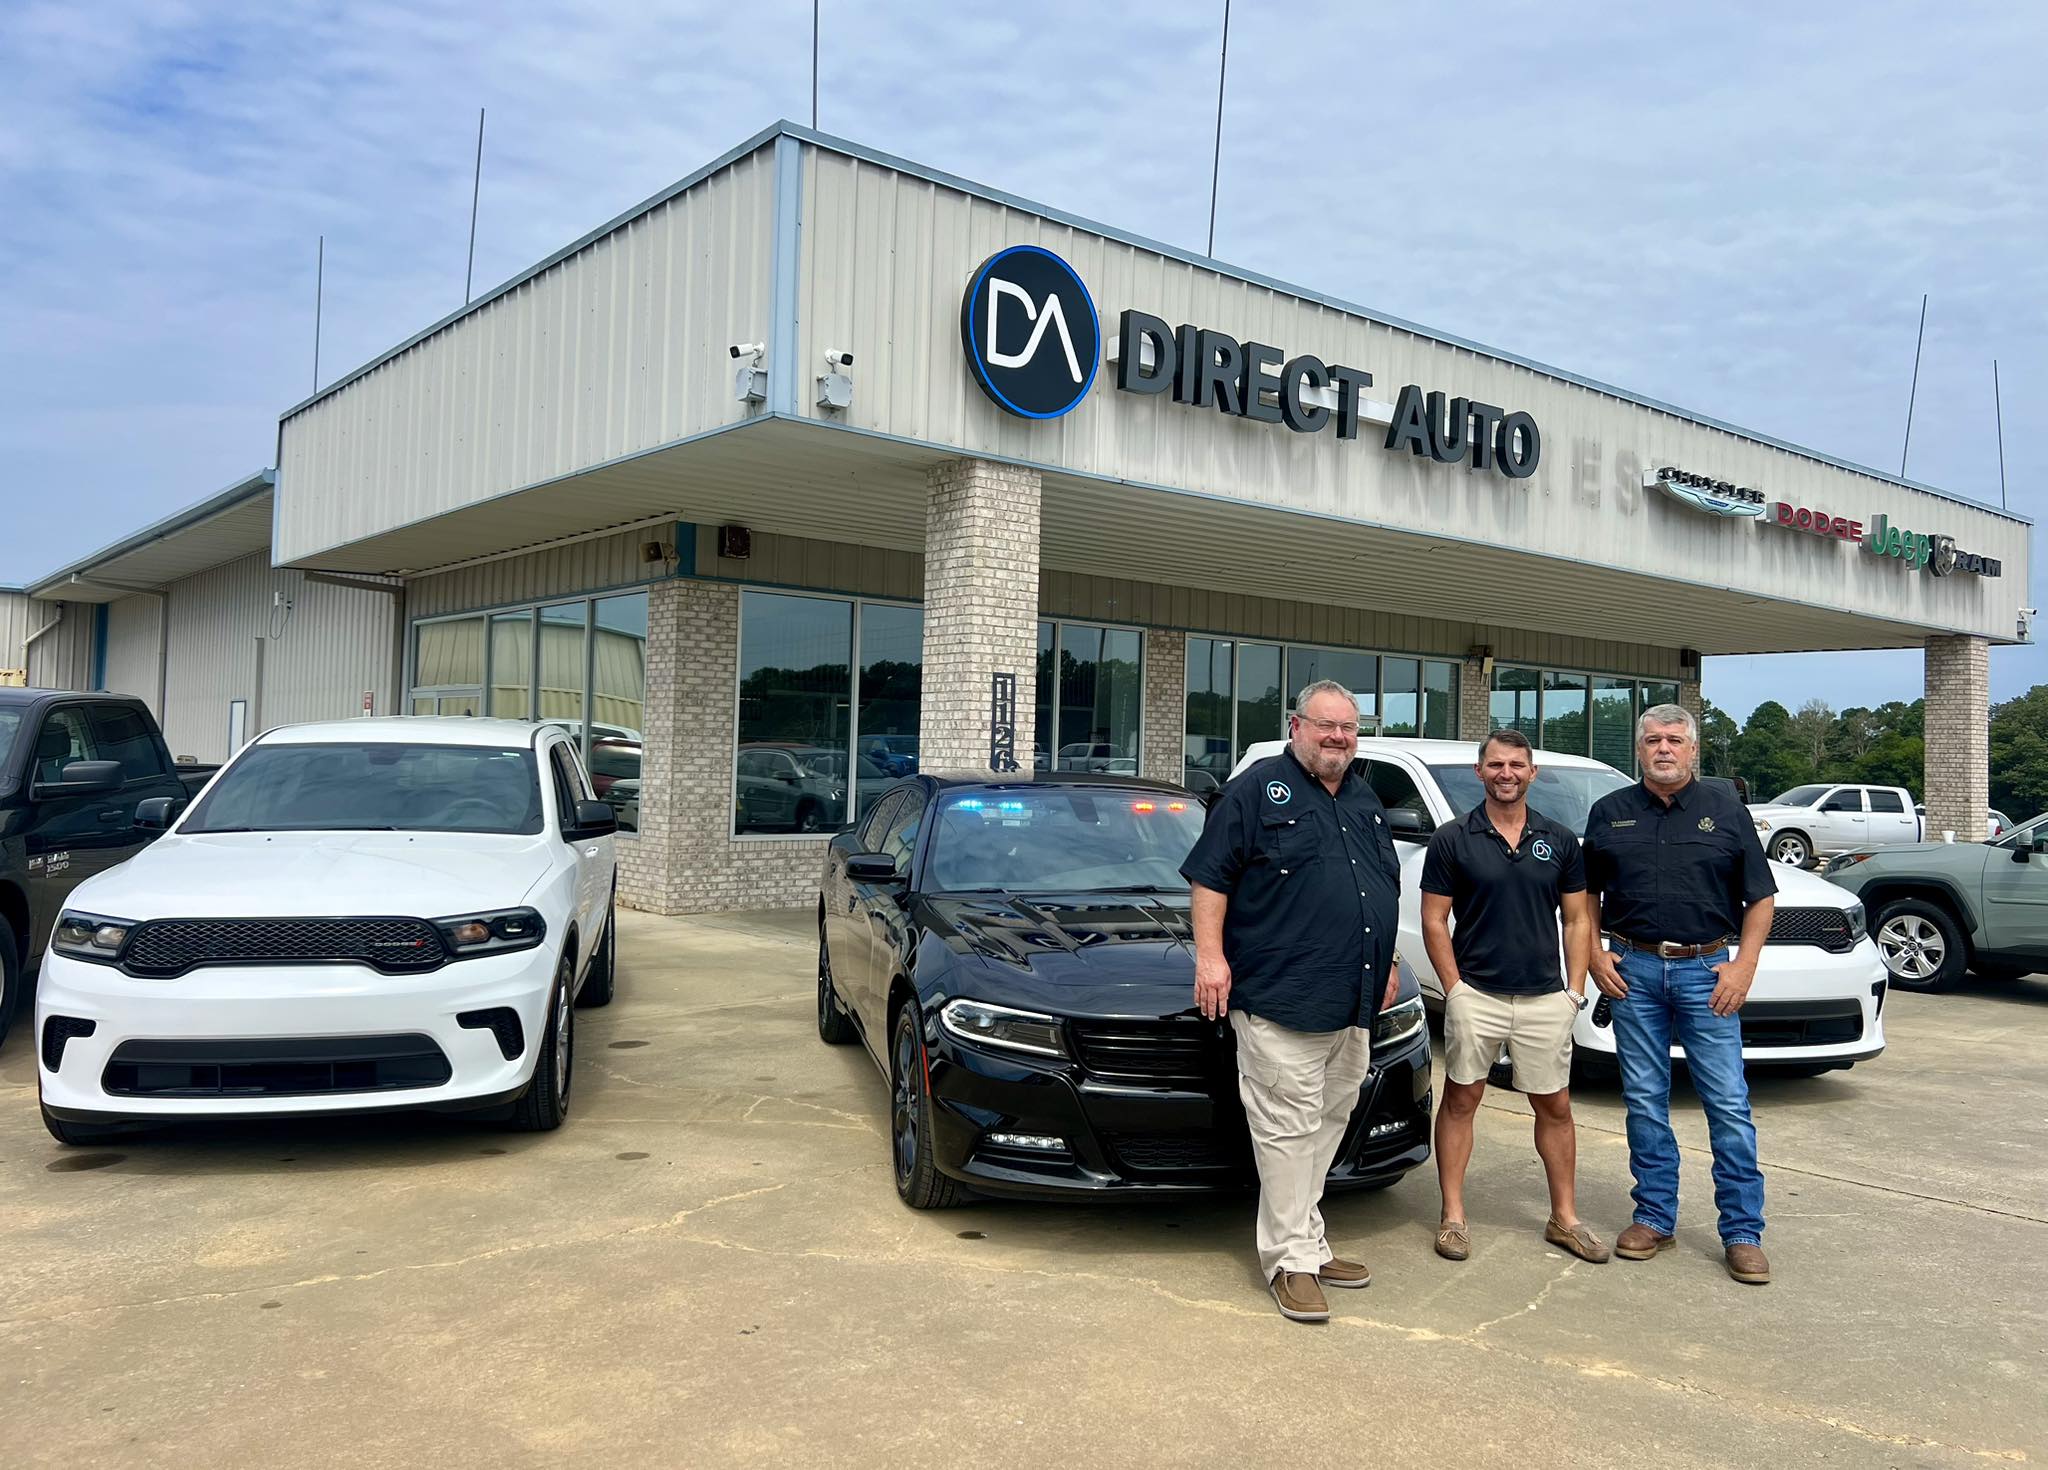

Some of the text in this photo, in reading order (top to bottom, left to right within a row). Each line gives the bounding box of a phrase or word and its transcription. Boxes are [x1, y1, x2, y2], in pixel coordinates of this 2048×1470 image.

[1117, 308, 1541, 479] DIRECT AUTO
[1656, 466, 1766, 504] CHRYSLER
[1776, 502, 1863, 543] DODGE
[1871, 514, 1931, 571] Jeep
[1955, 549, 2002, 578] RAM
[993, 674, 1016, 770] 1126
